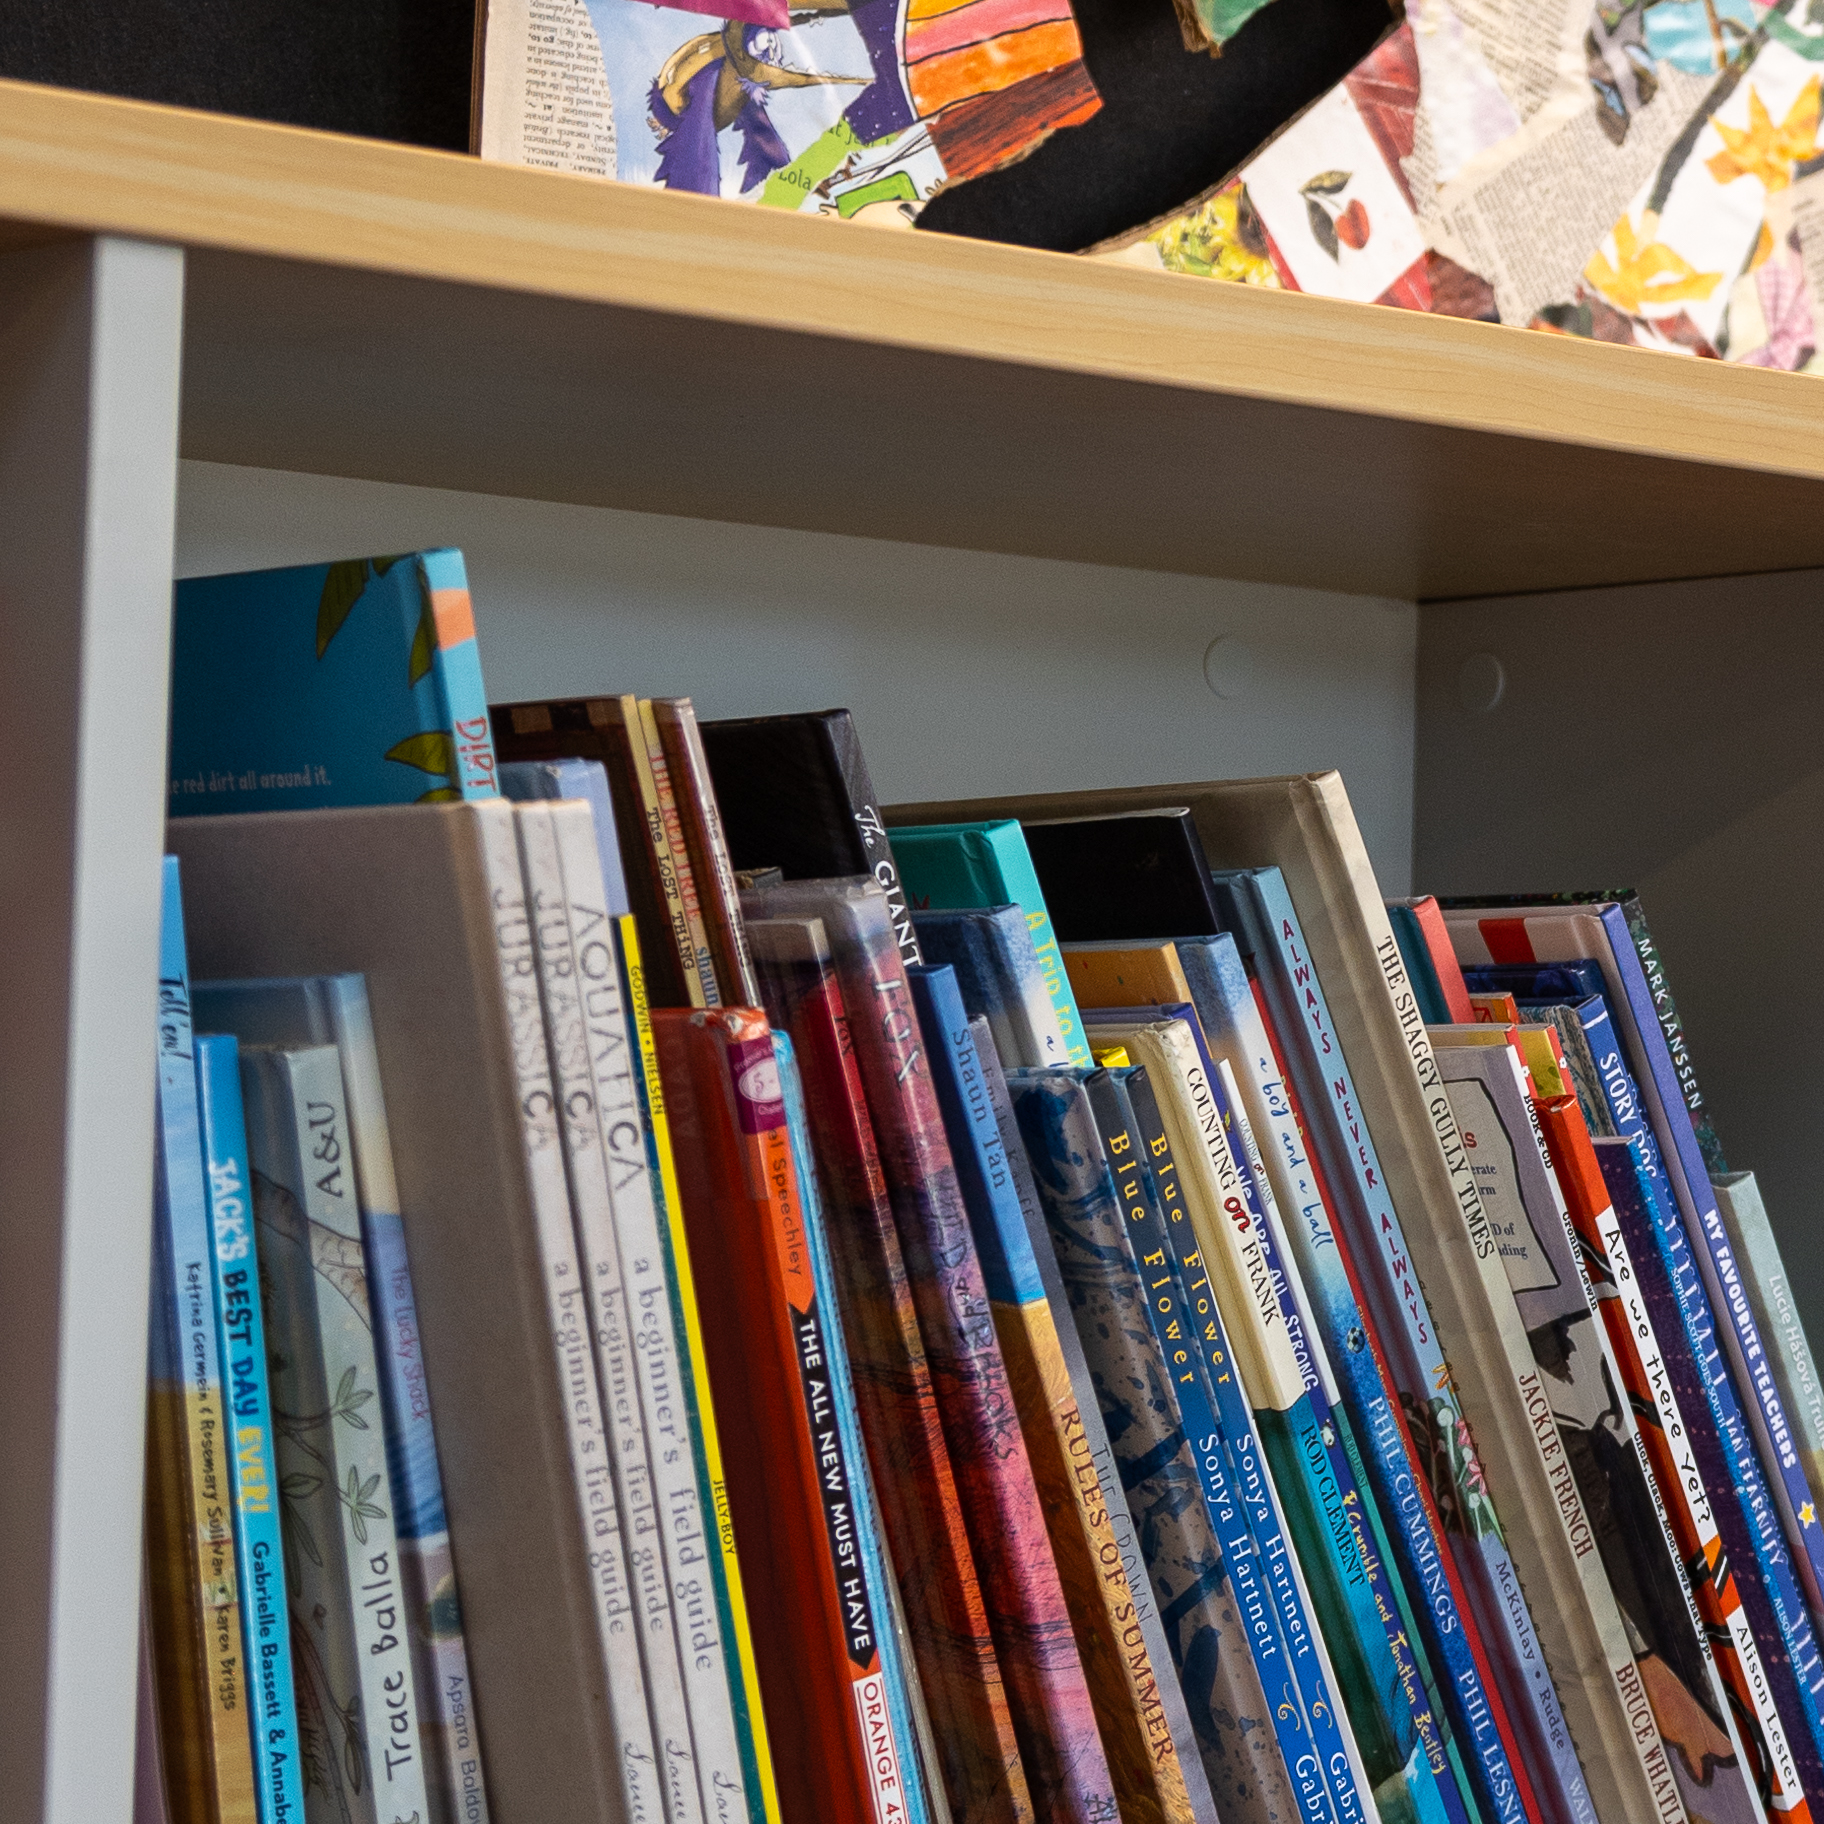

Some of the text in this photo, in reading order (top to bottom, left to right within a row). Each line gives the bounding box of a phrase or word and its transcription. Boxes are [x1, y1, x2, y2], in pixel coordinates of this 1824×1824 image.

[779, 167, 811, 191] Lola
[183, 764, 332, 794] red dirt all around it.
[454, 715, 499, 793] DIRT
[647, 807, 663, 843] The
[658, 854, 679, 900] LOST
[854, 805, 924, 966] The GIANT
[571, 902, 646, 1190] AQUATICA
[630, 965, 665, 1117] GODWIN NIELSEN
[951, 1027, 1007, 1190] Shaun Tan
[1375, 934, 1499, 1261] THE SHAGGY GULLY TIMES
[1599, 1051, 1638, 1127] STORY
[1636, 938, 1703, 1111] MARK JANSSEN
[1186, 1065, 1282, 1327] COUNTING on FRANK
[1258, 1056, 1335, 1249] a boy and a ball
[1282, 918, 1333, 1056] ALWAYS
[1333, 1075, 1380, 1190] NEVER
[1379, 1211, 1429, 1346] ALWAYS
[208, 1157, 271, 1513] JACK'S BEST DAY EVER!
[1108, 1129, 1195, 1385] Blue Flower
[1702, 1208, 1798, 1471] MY FAVOURITE TEACHERS
[554, 1259, 631, 1637] a beginner's field guide
[1604, 1227, 1715, 1527] Are we there Yet?
[712, 1479, 735, 1556] JELLY-BOY
[799, 1319, 872, 1652] THE ALL NEW MUST HAVE
[1198, 1432, 1278, 1661] Sonya Hartnett
[1299, 1424, 1366, 1588] ROD CLEMENT
[1518, 1370, 1597, 1561] JACKIE FRENCH
[252, 1540, 276, 1639] Gabrielle
[1059, 1408, 1175, 1763] RULES OF SUMMER
[1367, 1395, 1397, 1473] PHIL
[1395, 1472, 1458, 1636] CUMMINGS
[1457, 1668, 1487, 1742] PHIL
[261, 1642, 281, 1720] Bassett
[267, 1728, 287, 1747] &
[448, 1674, 470, 1750] Apsara
[863, 1681, 896, 1794] ORANGE
[1495, 1559, 1566, 1751] McKinlay Rudge
[1614, 1661, 1657, 1744] BRUCE
[1734, 1622, 1799, 1793] Alison Lester
